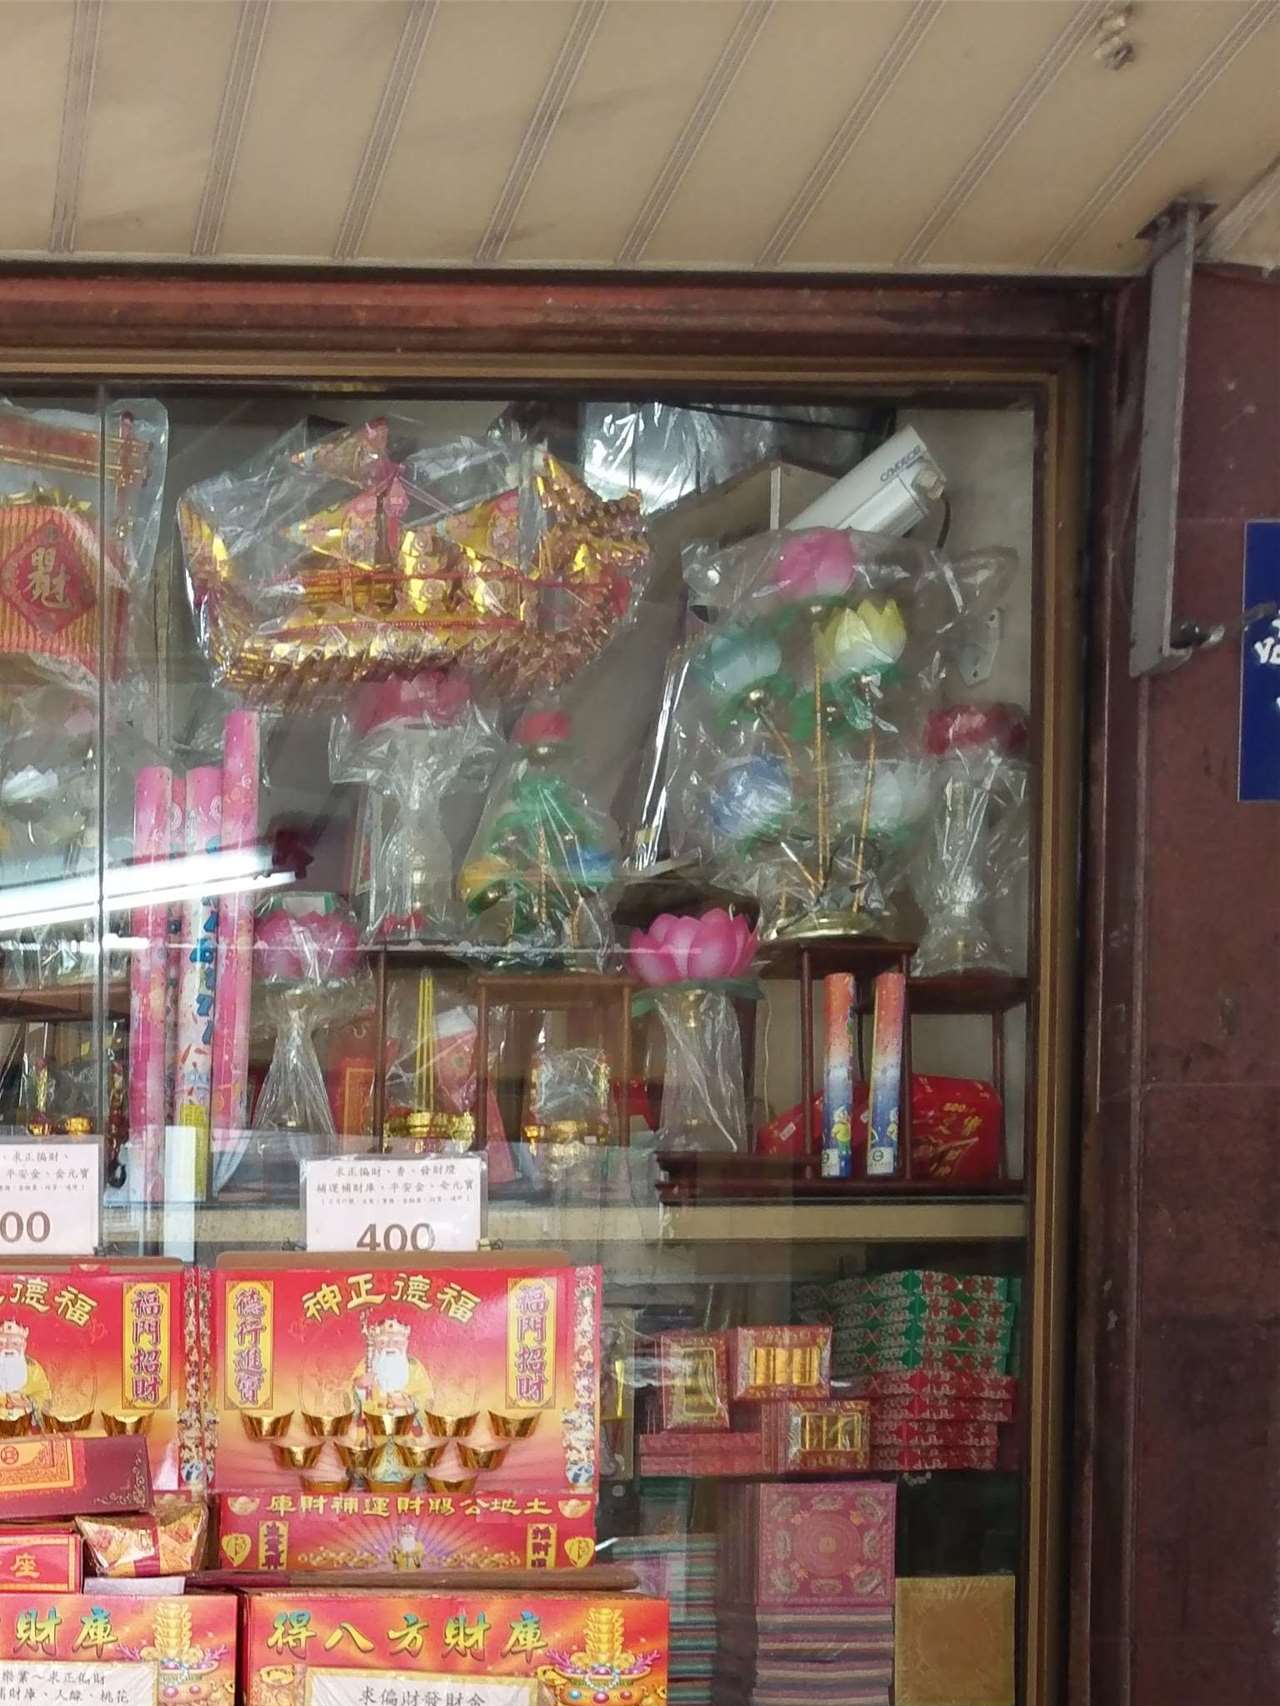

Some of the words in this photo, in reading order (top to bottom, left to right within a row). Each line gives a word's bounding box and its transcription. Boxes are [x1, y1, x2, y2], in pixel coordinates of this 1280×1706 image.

[356, 1222, 436, 1251] 400
[267, 1610, 549, 1662] 得八方財庫
